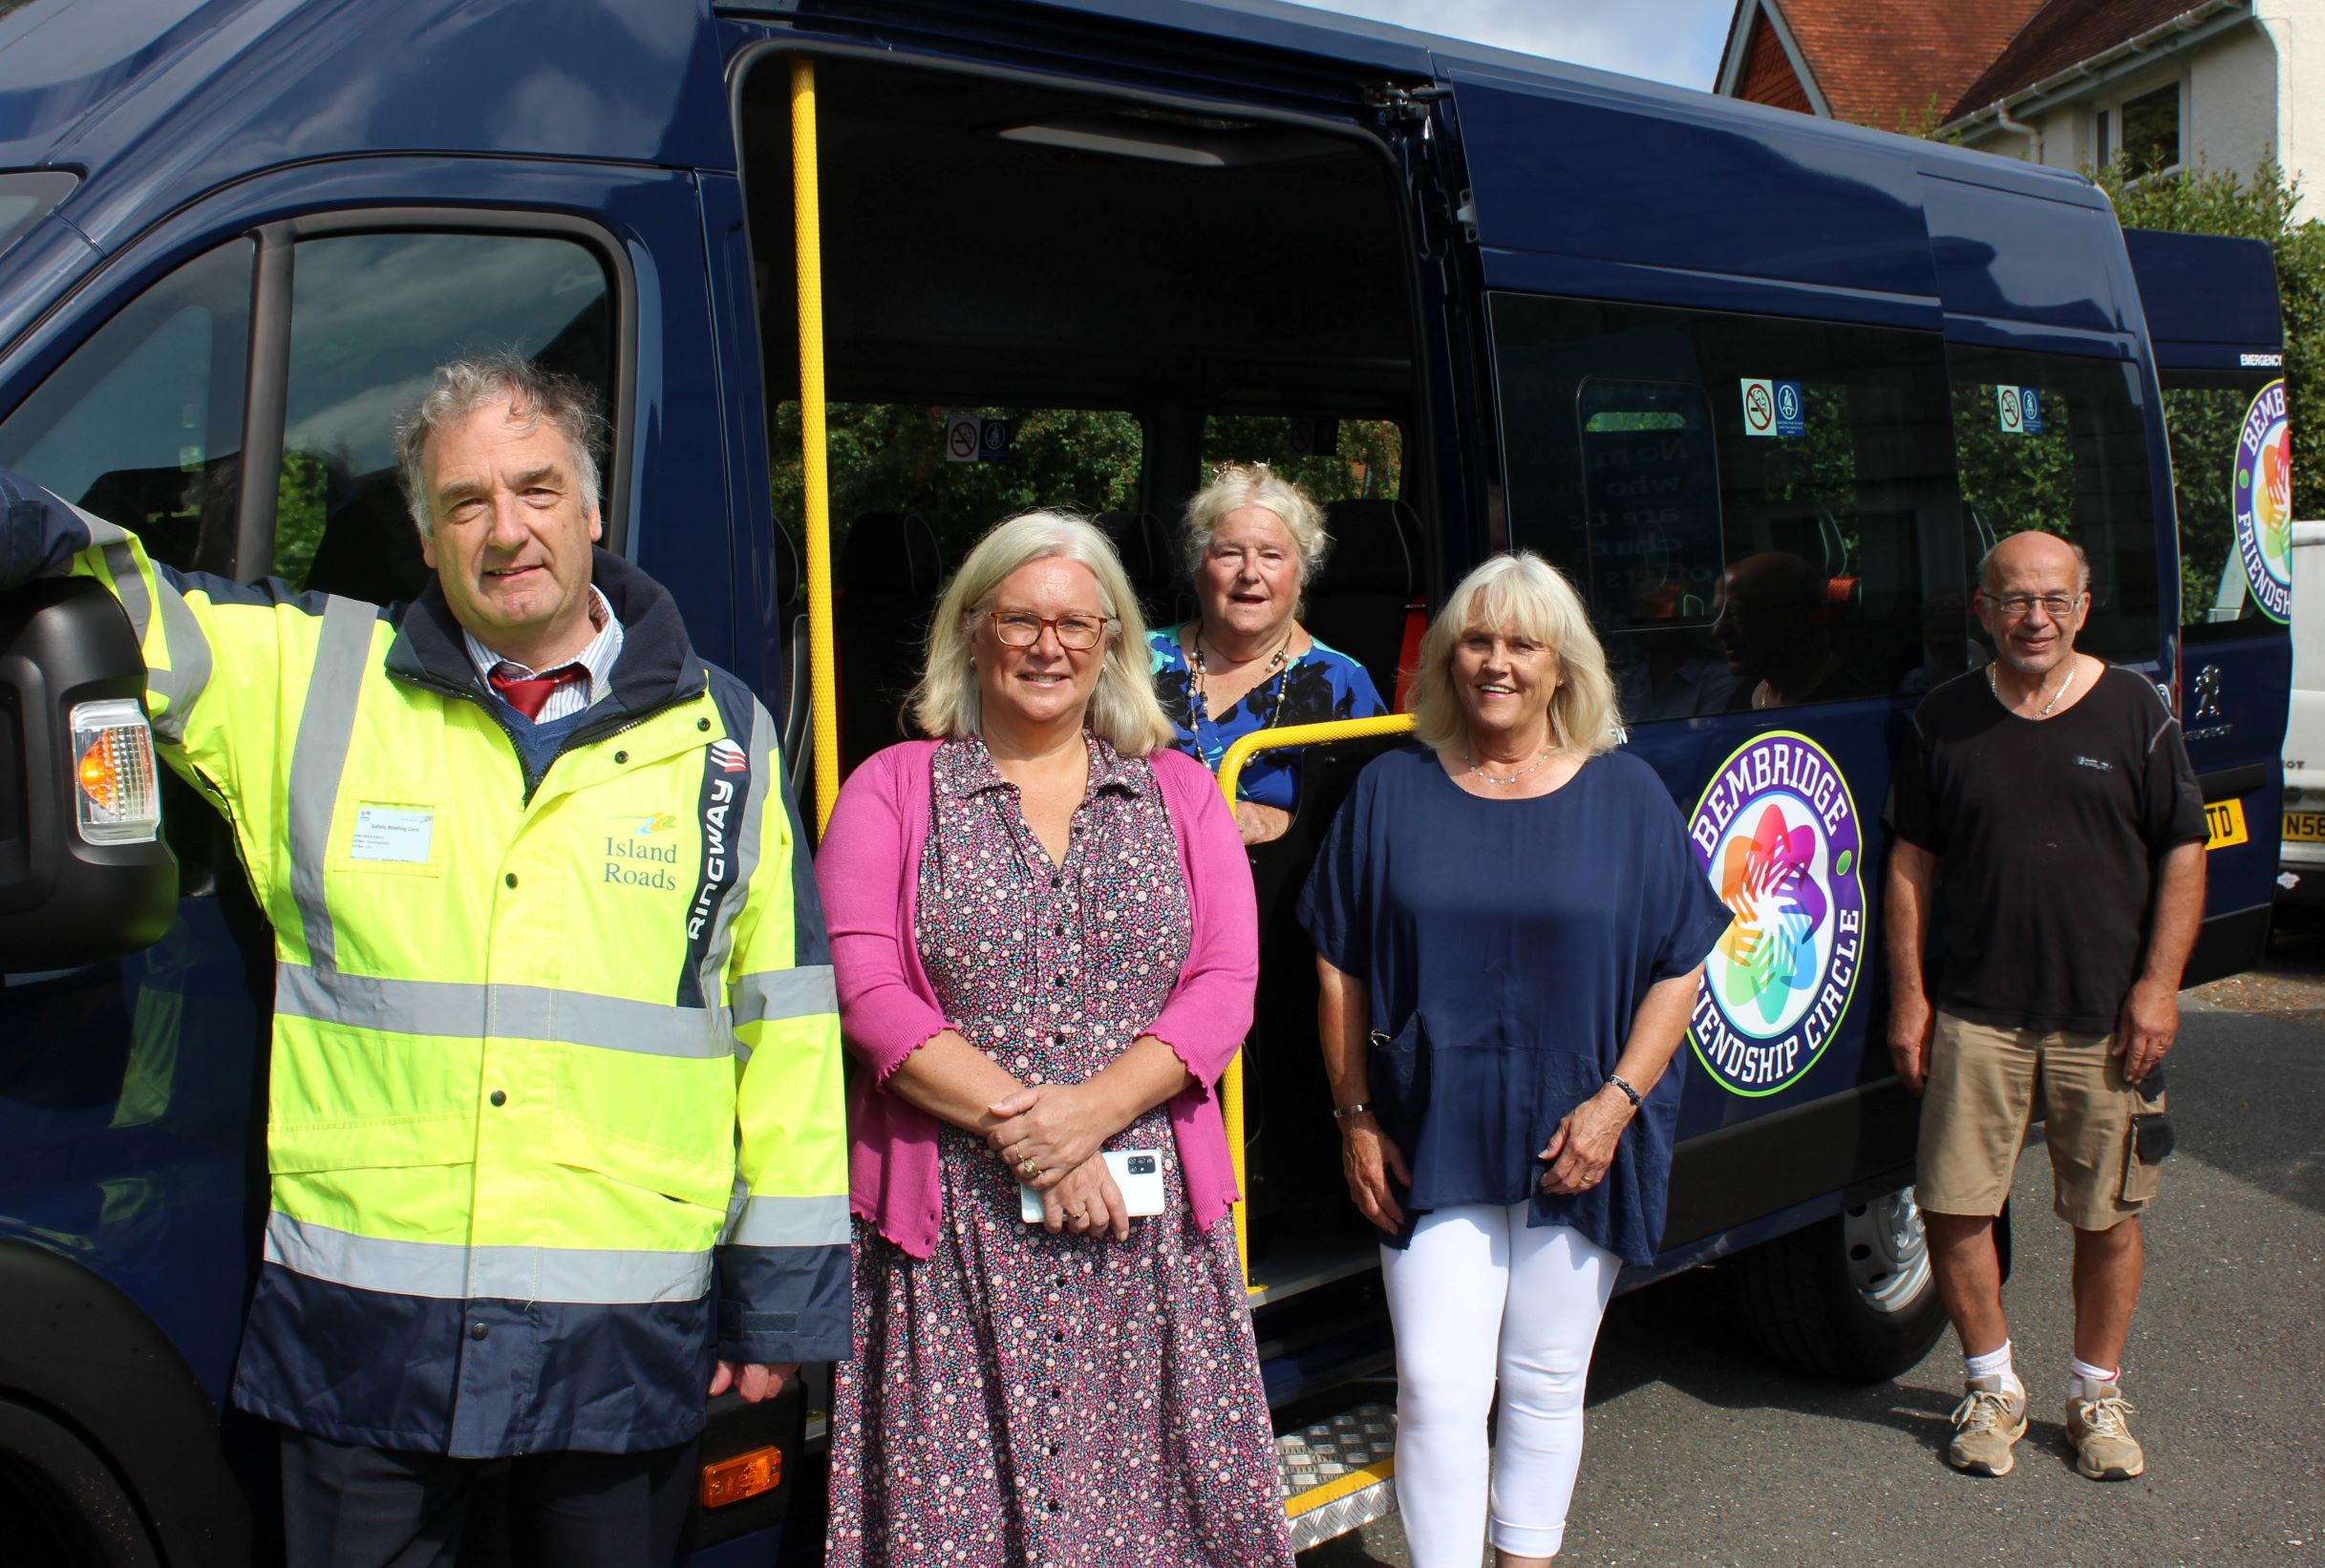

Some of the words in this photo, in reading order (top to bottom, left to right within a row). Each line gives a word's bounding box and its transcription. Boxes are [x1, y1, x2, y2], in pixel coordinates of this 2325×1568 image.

[2242, 388, 2286, 456] BEMB
[2237, 510, 2291, 615] FRIENDSH
[1692, 744, 1848, 858] BEMBRIDGE
[2206, 805, 2233, 839] TD
[2286, 815, 2325, 837] N58
[604, 862, 676, 891] Roads
[605, 837, 677, 864] Island
[688, 778, 734, 941] RINGWAY
[1692, 974, 1799, 1084] IENDSHIP
[1804, 909, 1859, 1050] CIRCLE
